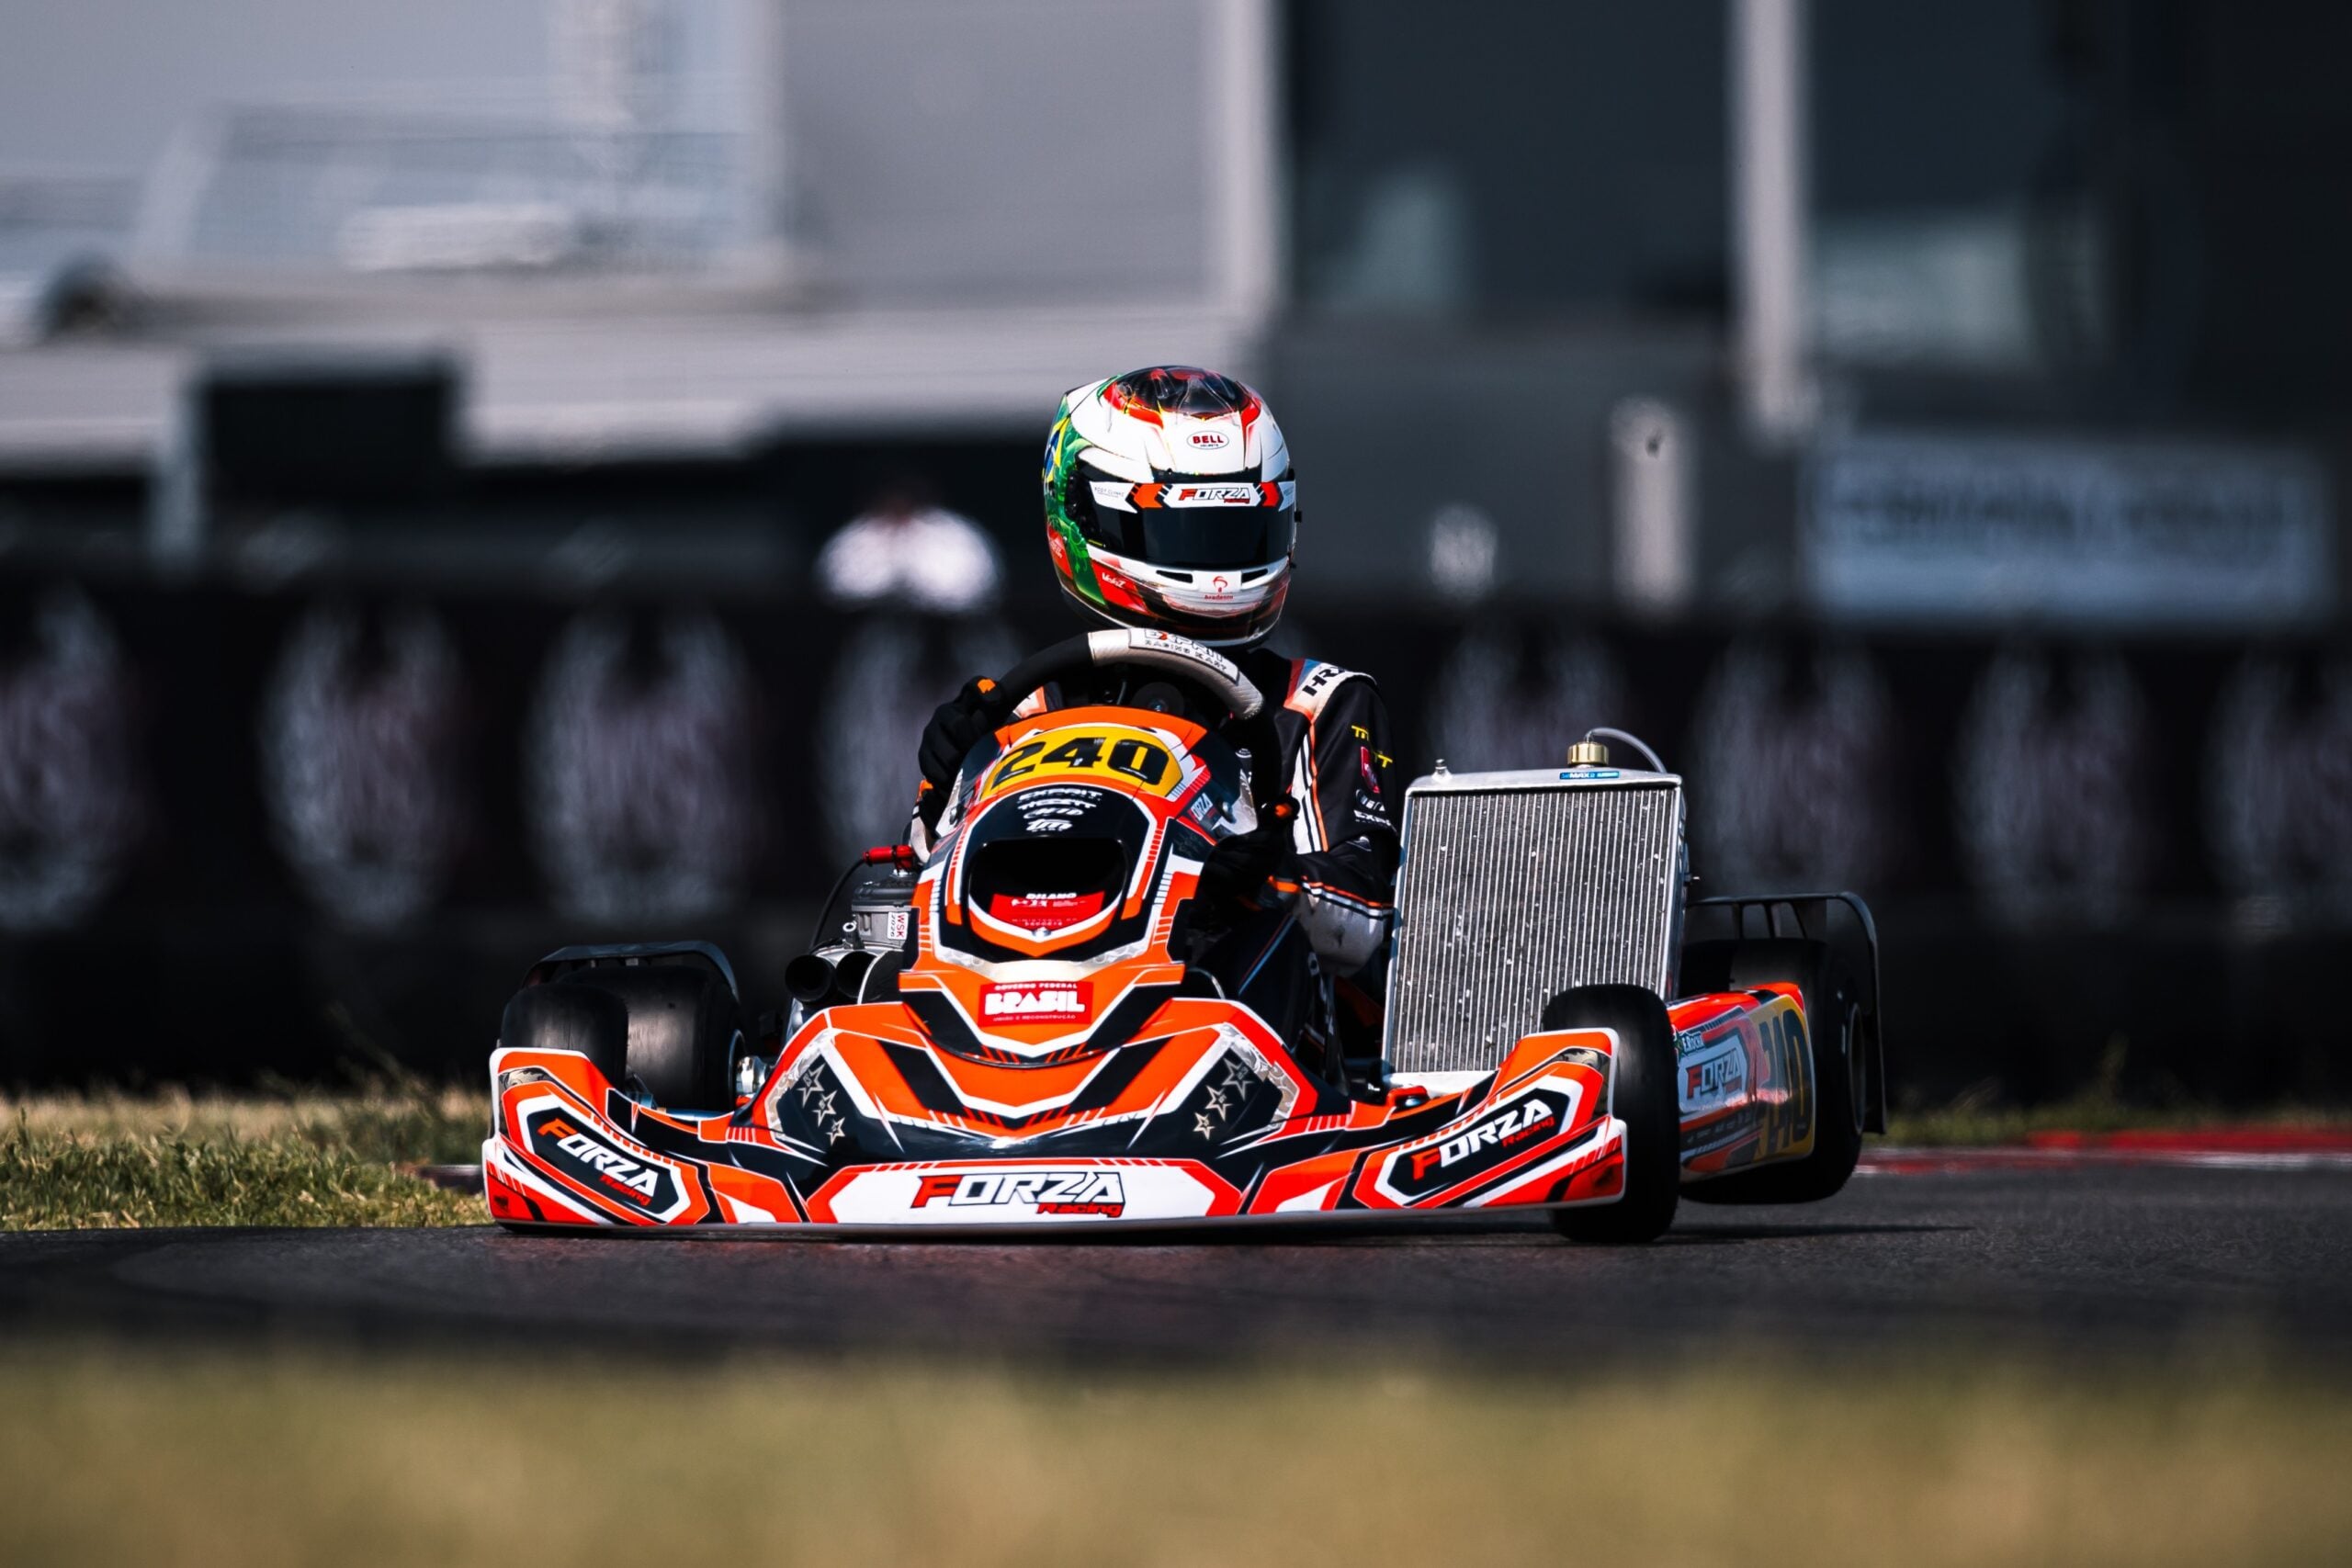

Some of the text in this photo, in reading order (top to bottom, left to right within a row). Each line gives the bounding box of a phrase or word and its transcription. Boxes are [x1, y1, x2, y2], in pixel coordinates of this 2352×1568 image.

[1193, 434, 1225, 444] BELL
[1179, 488, 1250, 501] FORZA
[991, 738, 1170, 791] 240
[896, 913, 905, 938] WSK
[985, 991, 1085, 1015] BRASIL
[1686, 1047, 1741, 1100] FORZA
[1411, 1099, 1553, 1180] FORZA
[1502, 1116, 1555, 1147] Racing
[537, 1118, 659, 1197] FORZA
[600, 1173, 651, 1206] Racing
[910, 1171, 1126, 1208] FORZA
[1036, 1202, 1125, 1218] Racing
